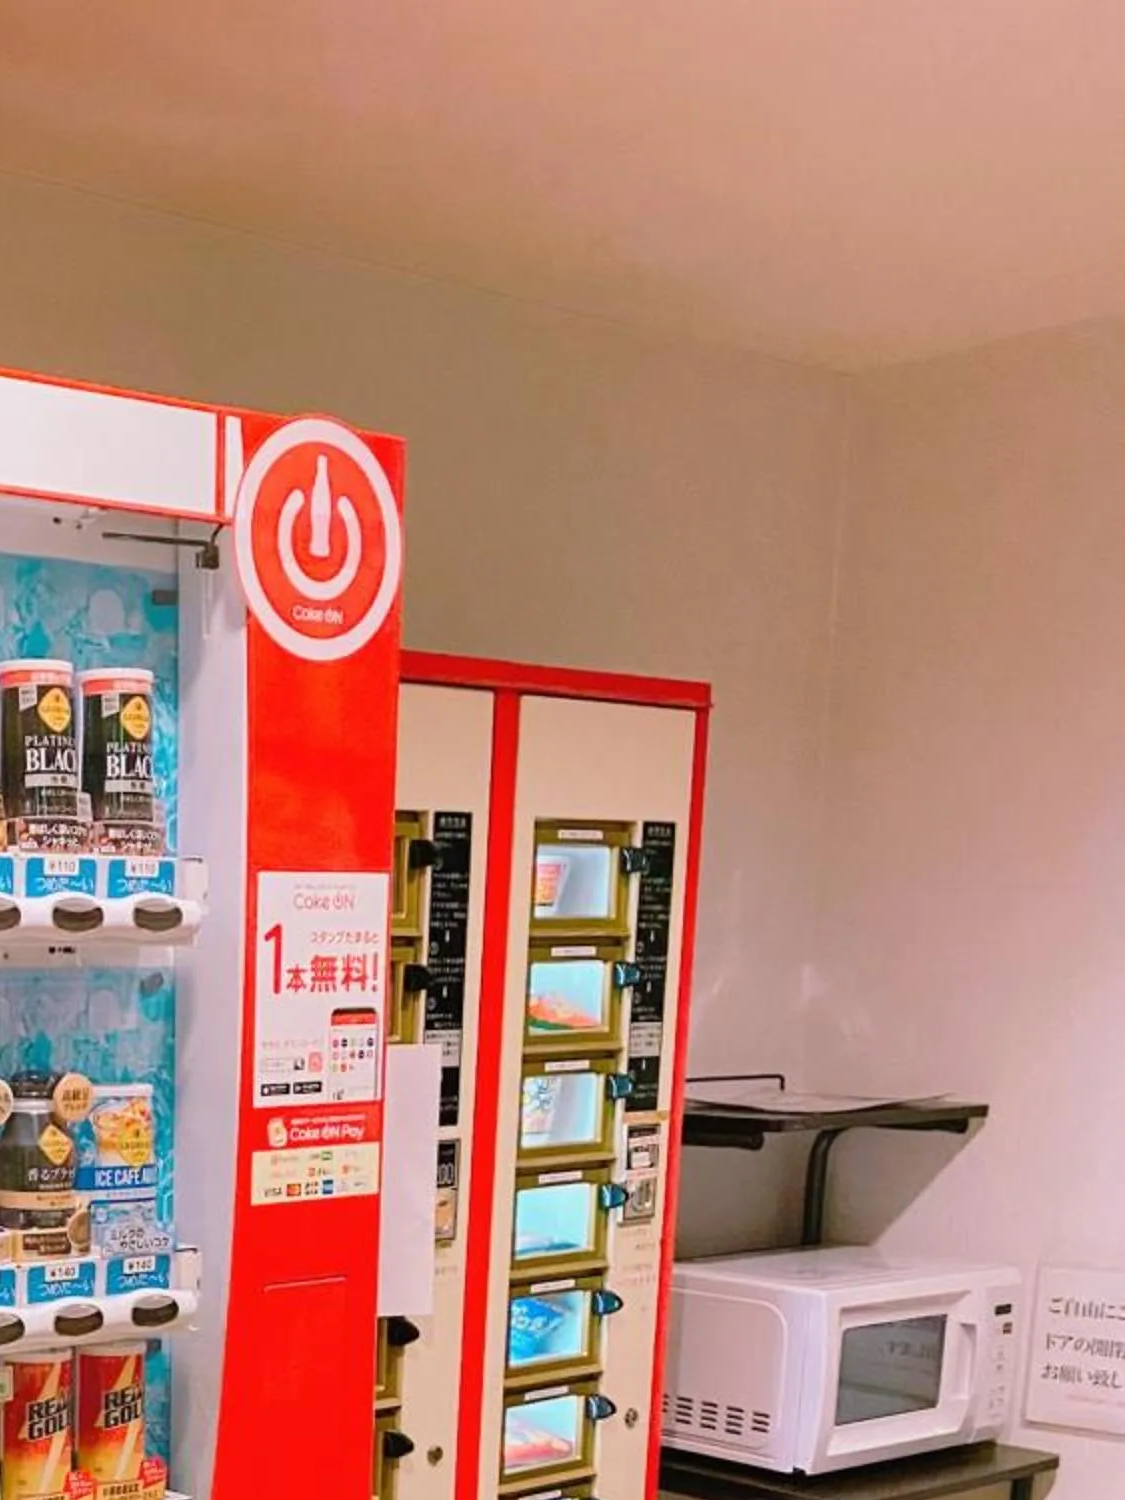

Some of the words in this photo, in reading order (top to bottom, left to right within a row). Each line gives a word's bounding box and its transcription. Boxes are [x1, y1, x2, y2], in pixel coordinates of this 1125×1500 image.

[293, 893, 330, 911] Coke
[332, 892, 355, 909] ON
[95, 1169, 112, 1186] ICE
